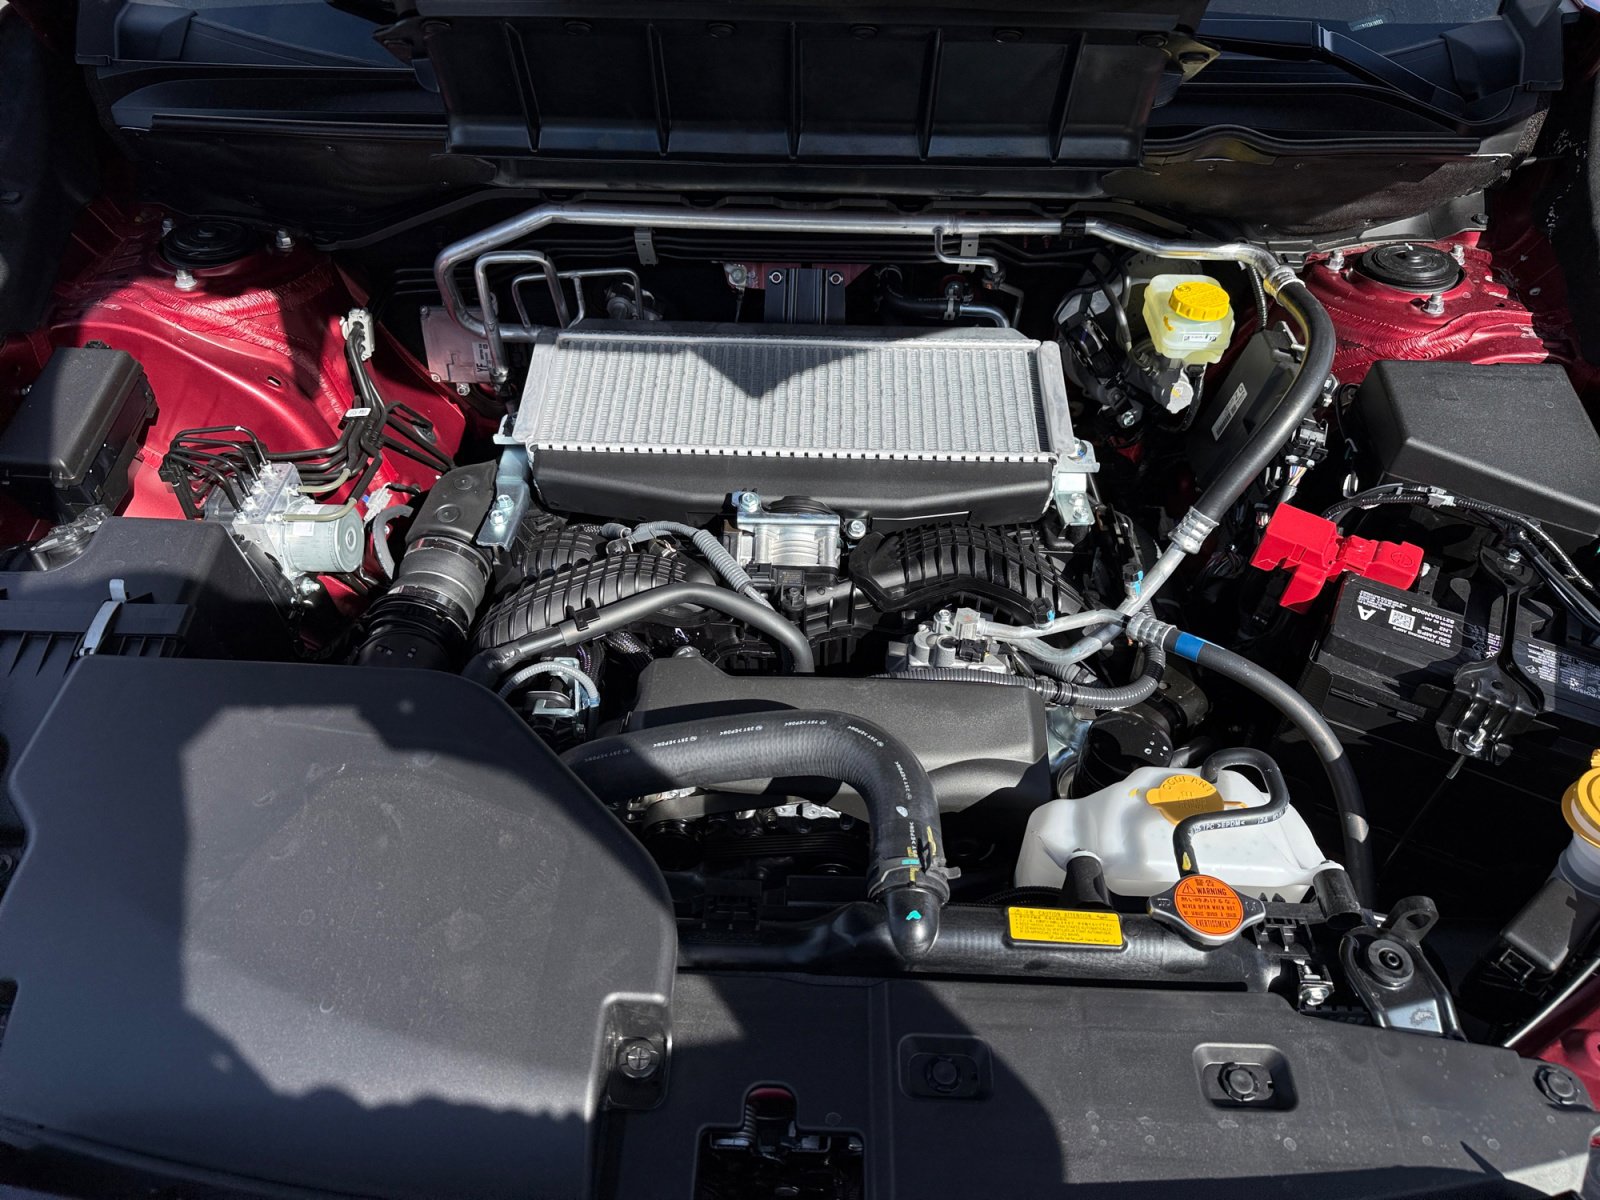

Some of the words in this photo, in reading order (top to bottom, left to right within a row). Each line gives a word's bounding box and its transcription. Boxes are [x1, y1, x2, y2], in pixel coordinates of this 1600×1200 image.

[1357, 605, 1376, 620] A
[1416, 629, 1437, 638] AMPS
[1216, 819, 1245, 828] >EPDM<
[1197, 888, 1227, 896] WARNING
